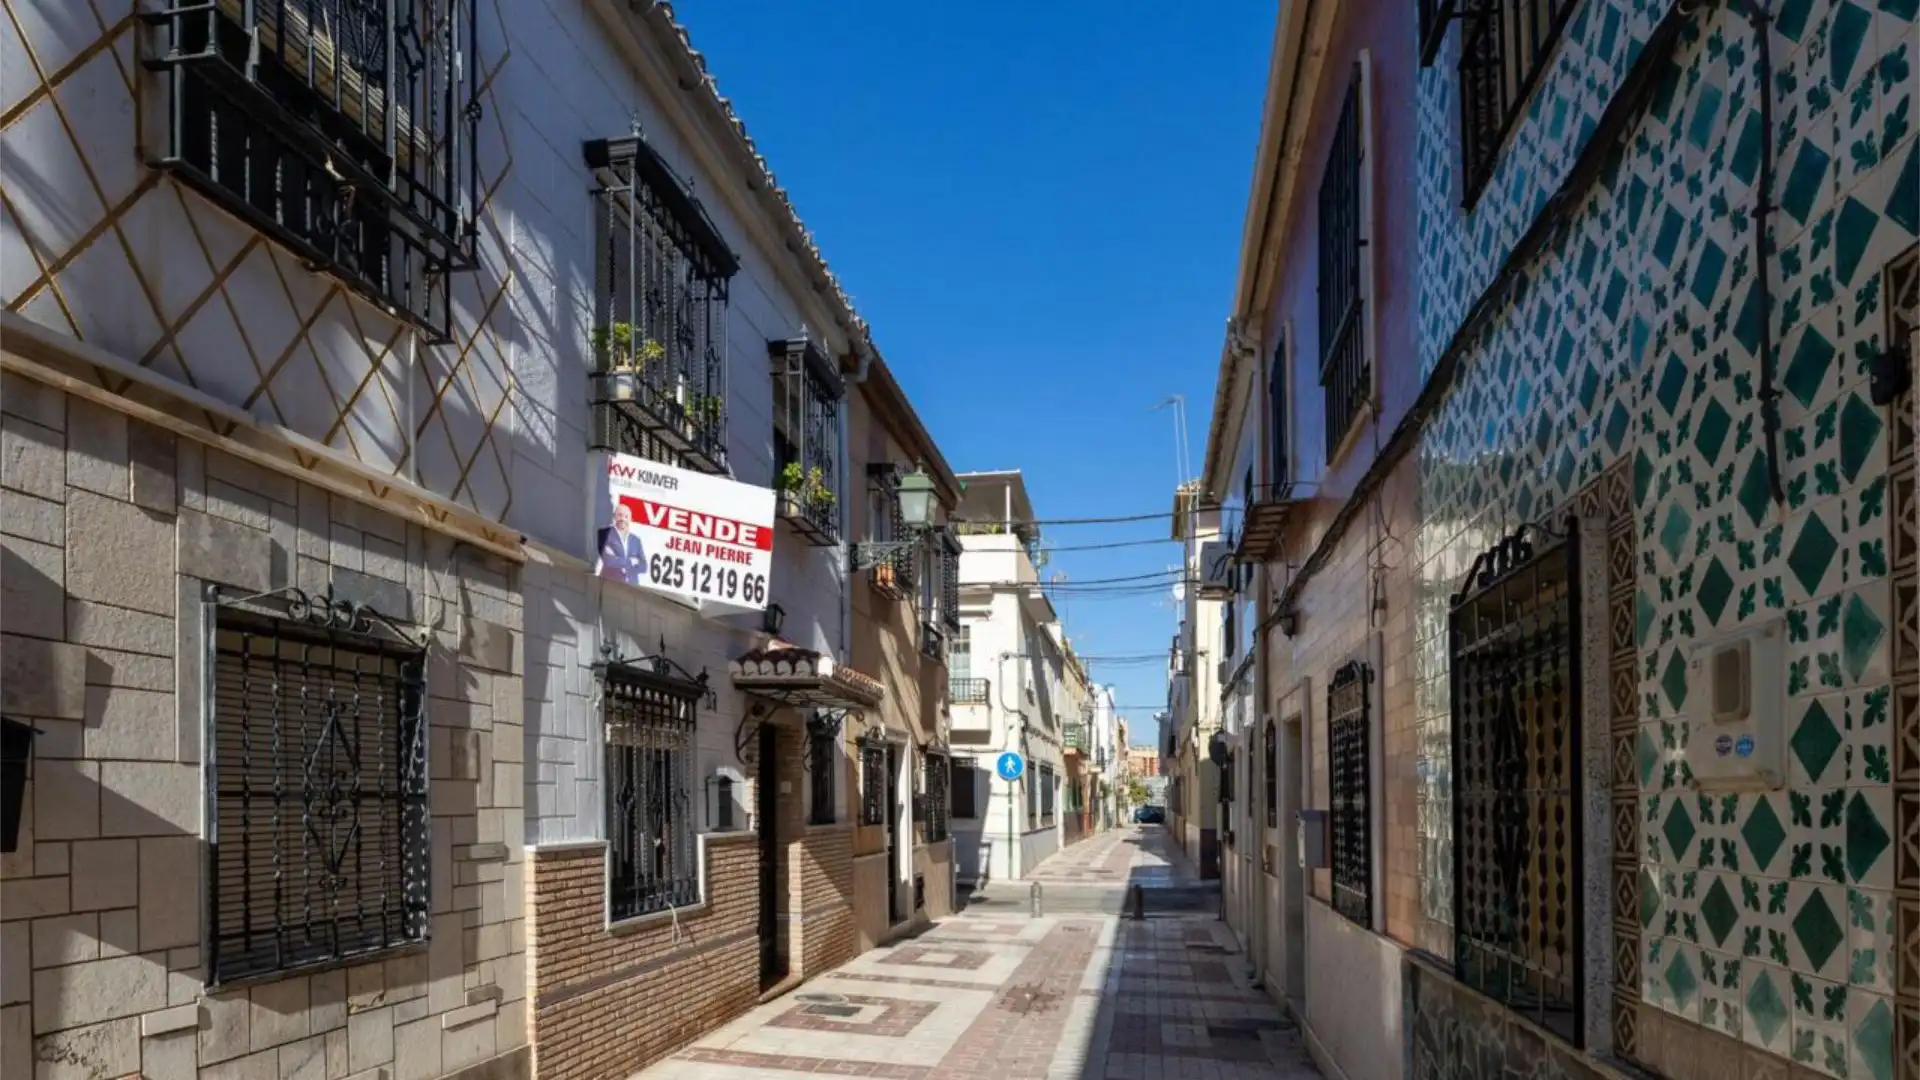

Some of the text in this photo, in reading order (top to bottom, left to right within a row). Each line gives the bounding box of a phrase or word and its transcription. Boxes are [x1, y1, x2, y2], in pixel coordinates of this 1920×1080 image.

[643, 503, 758, 547] VENDE
[665, 536, 753, 566] JEAN PIERRE
[650, 554, 764, 604] 625 12 19 66
